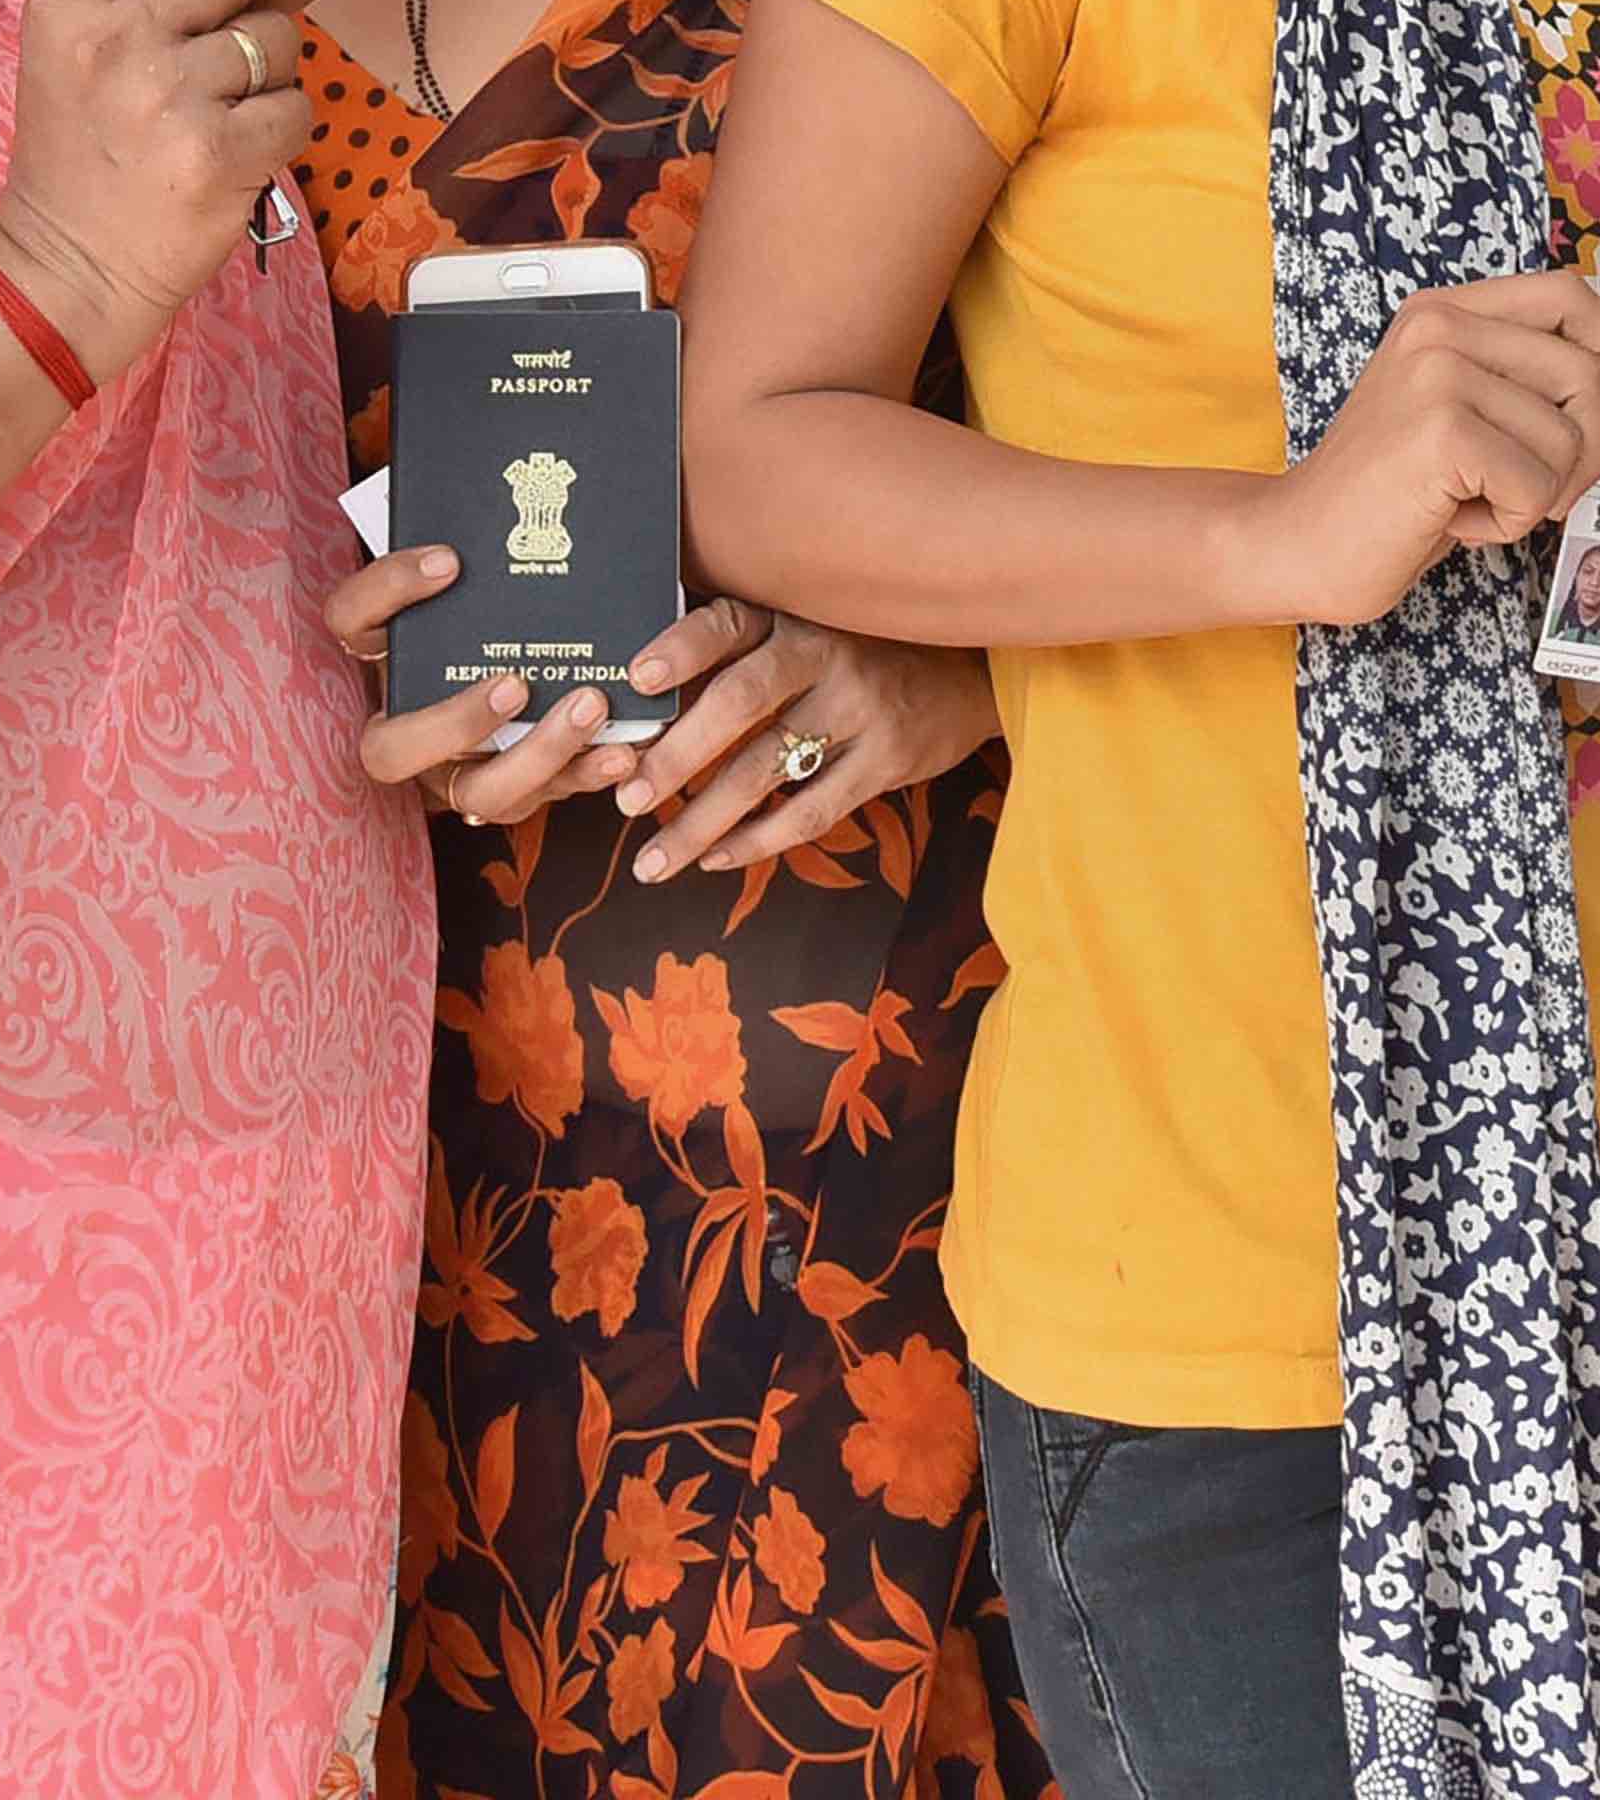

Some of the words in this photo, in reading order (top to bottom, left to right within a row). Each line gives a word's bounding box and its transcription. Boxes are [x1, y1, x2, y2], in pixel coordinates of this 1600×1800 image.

[511, 349, 573, 369] पासपोर्ट
[491, 377, 593, 394] PASSPORT
[482, 643, 521, 659] भारत
[524, 643, 593, 659] गणराज्य
[543, 665, 569, 682] OF
[573, 665, 629, 682] INDIA
